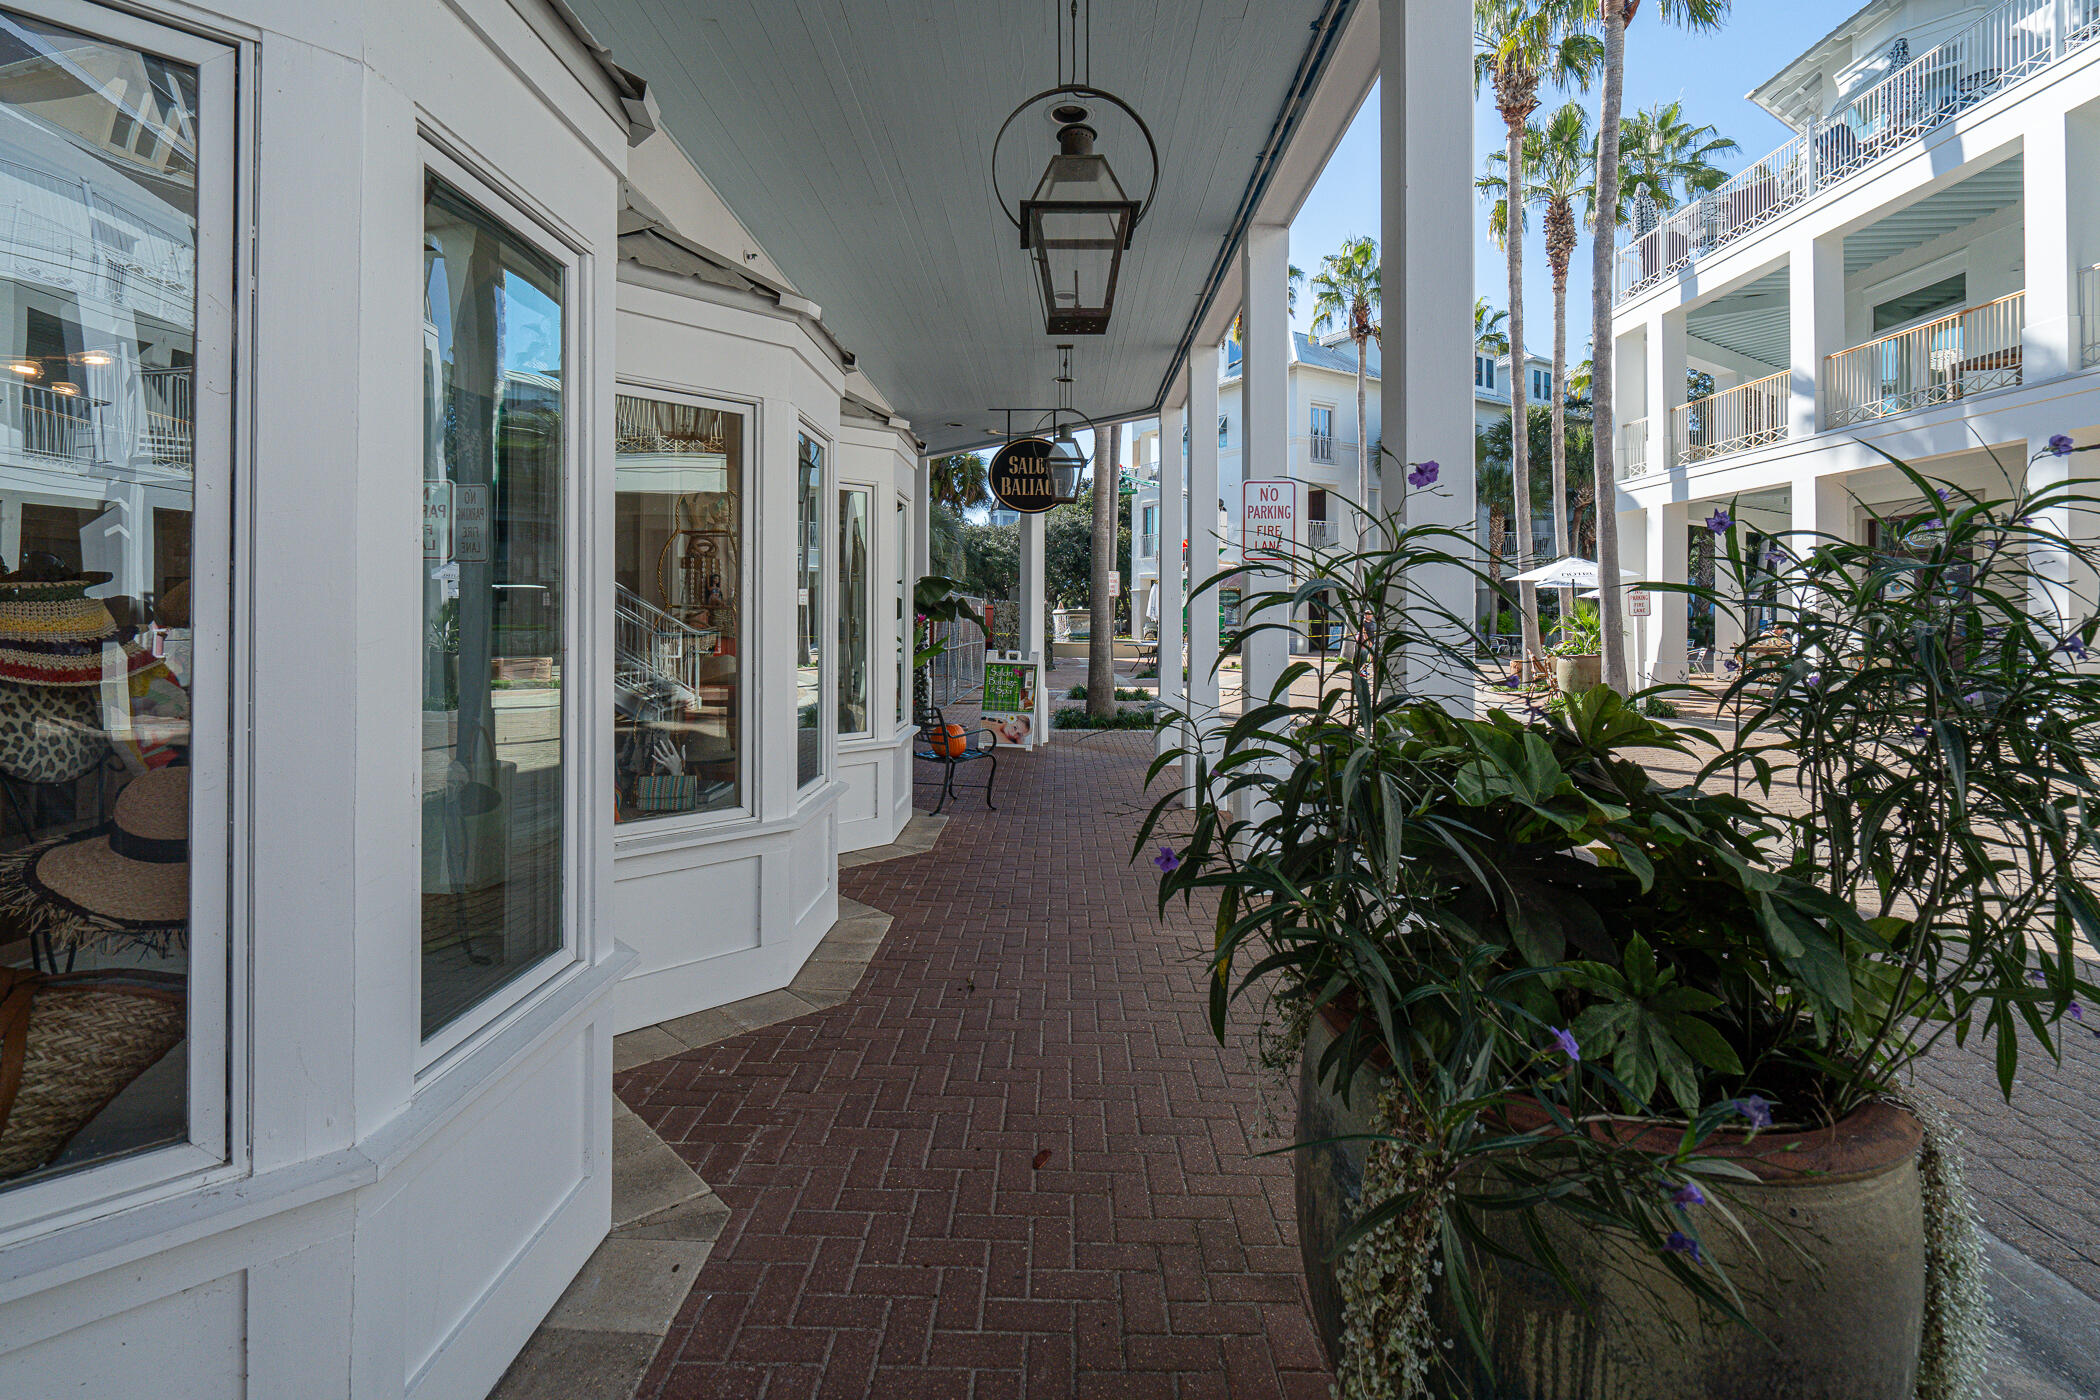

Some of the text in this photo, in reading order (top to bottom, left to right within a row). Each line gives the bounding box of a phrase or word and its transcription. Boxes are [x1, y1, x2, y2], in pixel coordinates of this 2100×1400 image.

[1009, 456, 1054, 475] SALO
[1260, 488, 1279, 502] NO
[1247, 505, 1291, 519] PARKING
[1256, 525, 1281, 537] FIRE
[1254, 540, 1284, 552] LANE
[990, 667, 1014, 677] Salon
[996, 685, 1012, 698] Spa
